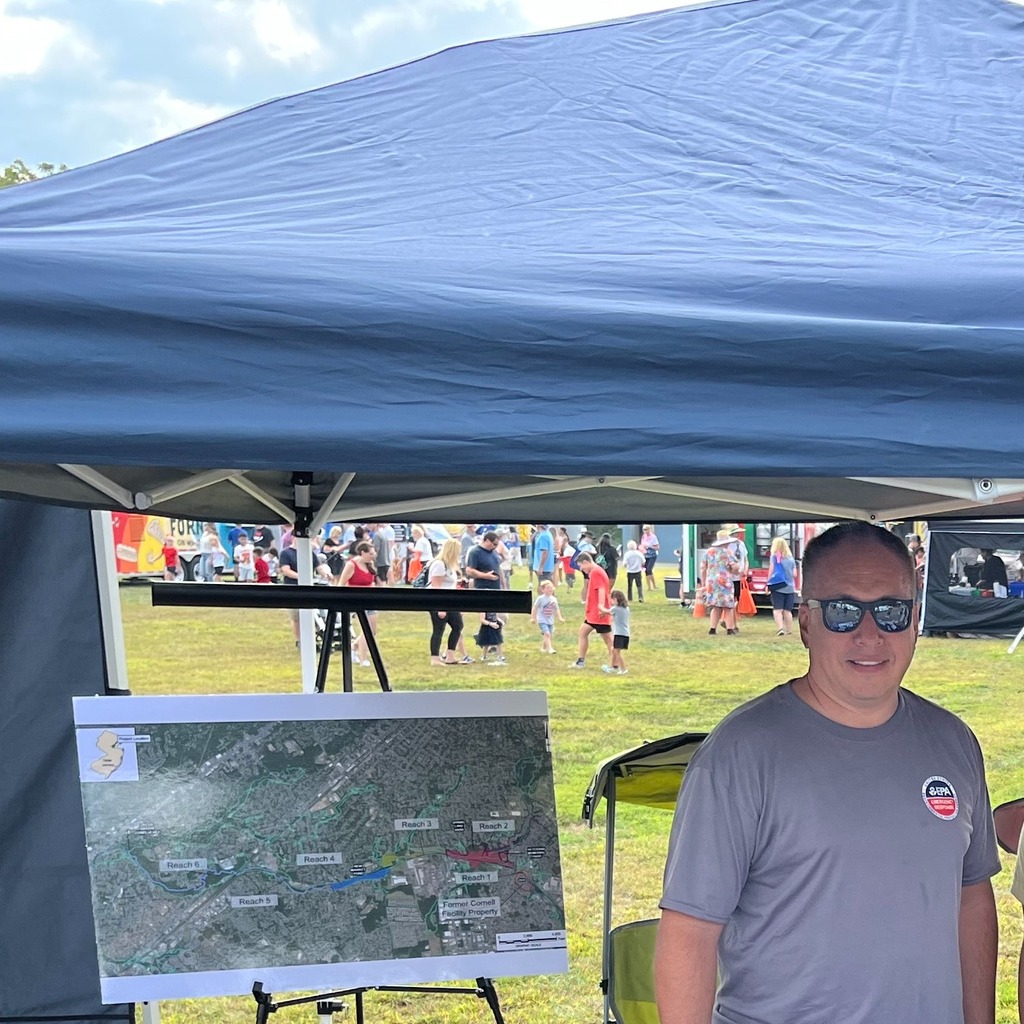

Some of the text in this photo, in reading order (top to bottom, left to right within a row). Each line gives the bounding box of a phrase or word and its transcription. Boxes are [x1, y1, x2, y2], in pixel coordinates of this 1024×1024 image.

[936, 786, 952, 796] EPA
[304, 855, 335, 864] Reach 4
[239, 897, 263, 905] Reach
[468, 909, 498, 917] Property
